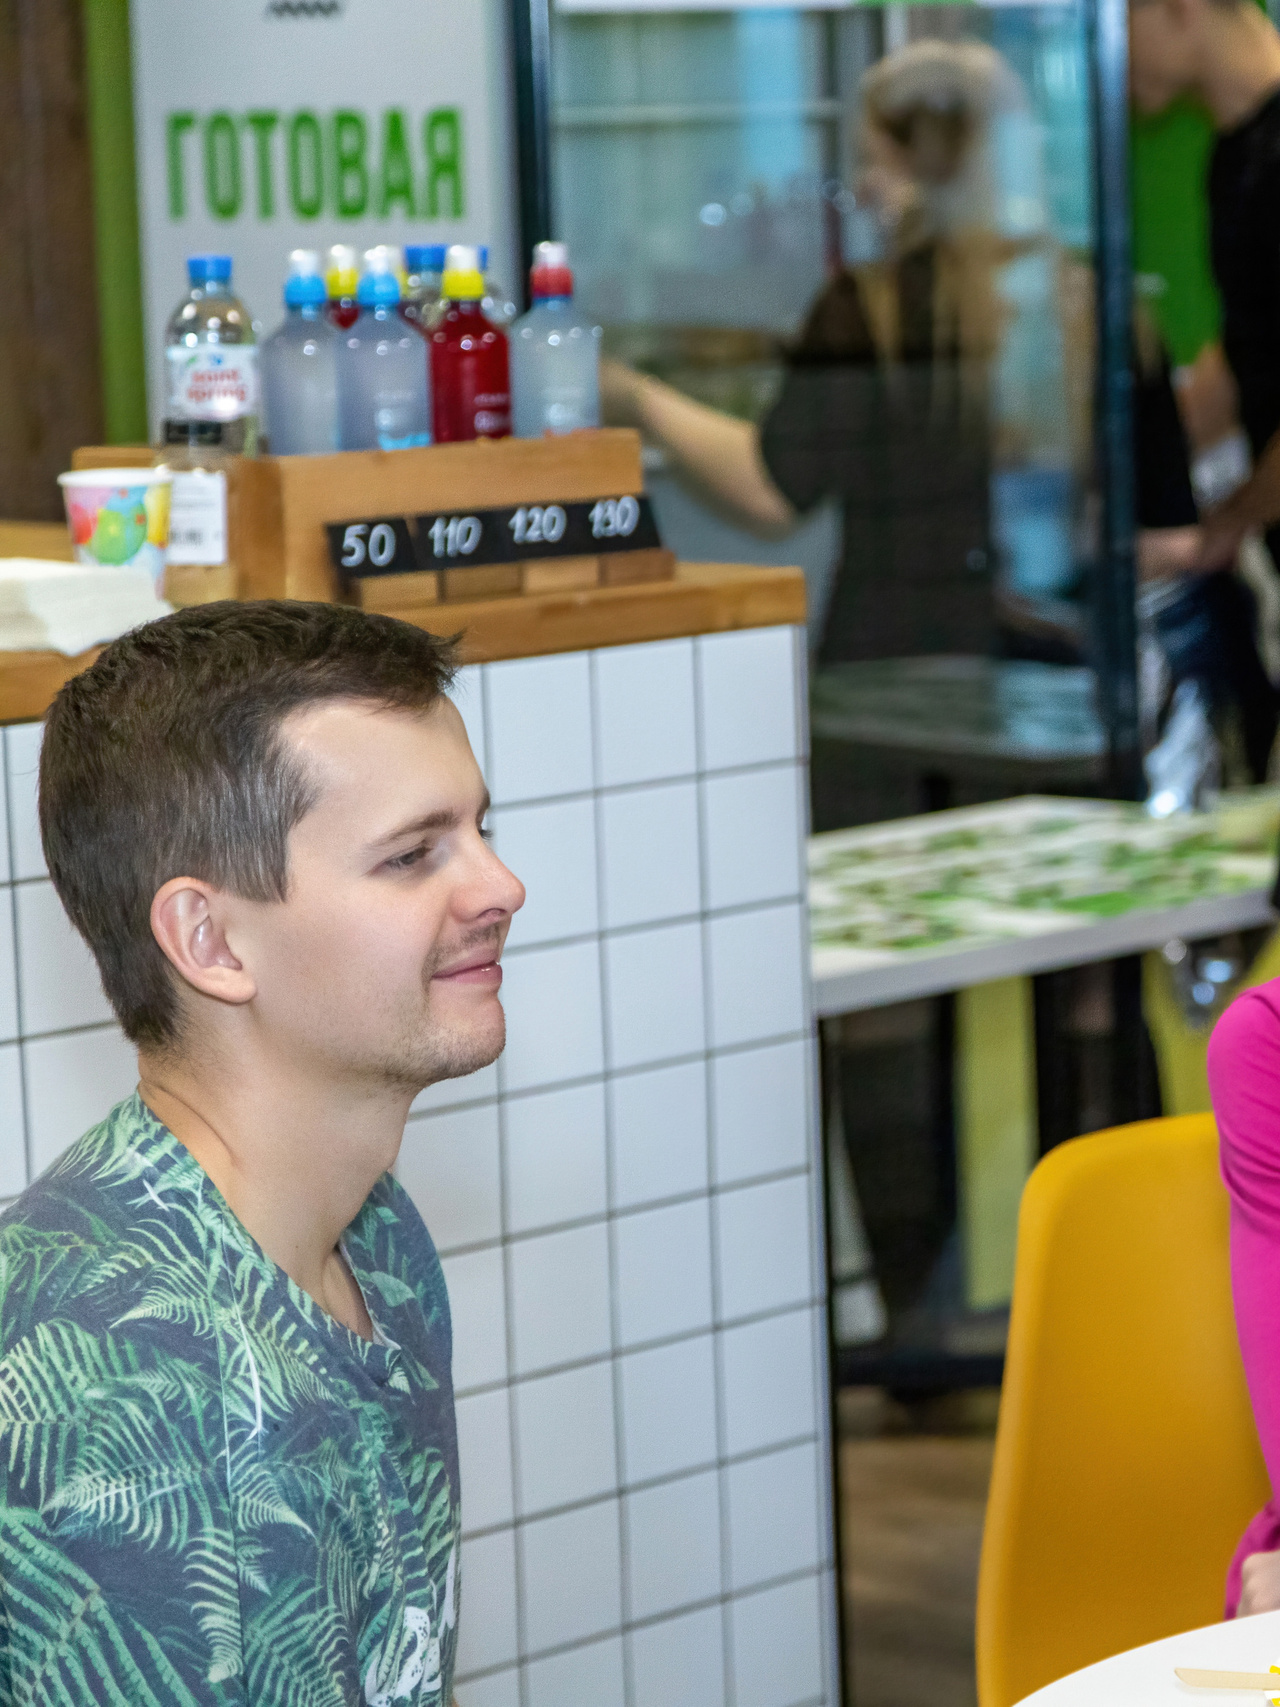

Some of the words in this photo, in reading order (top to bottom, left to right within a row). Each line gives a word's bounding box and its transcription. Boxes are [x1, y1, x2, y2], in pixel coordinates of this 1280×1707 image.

[167, 108, 465, 221] ГОТОВАЯ
[341, 523, 396, 567] 50
[428, 516, 482, 558] 110
[509, 505, 567, 543] 120
[588, 495, 641, 539] 130
